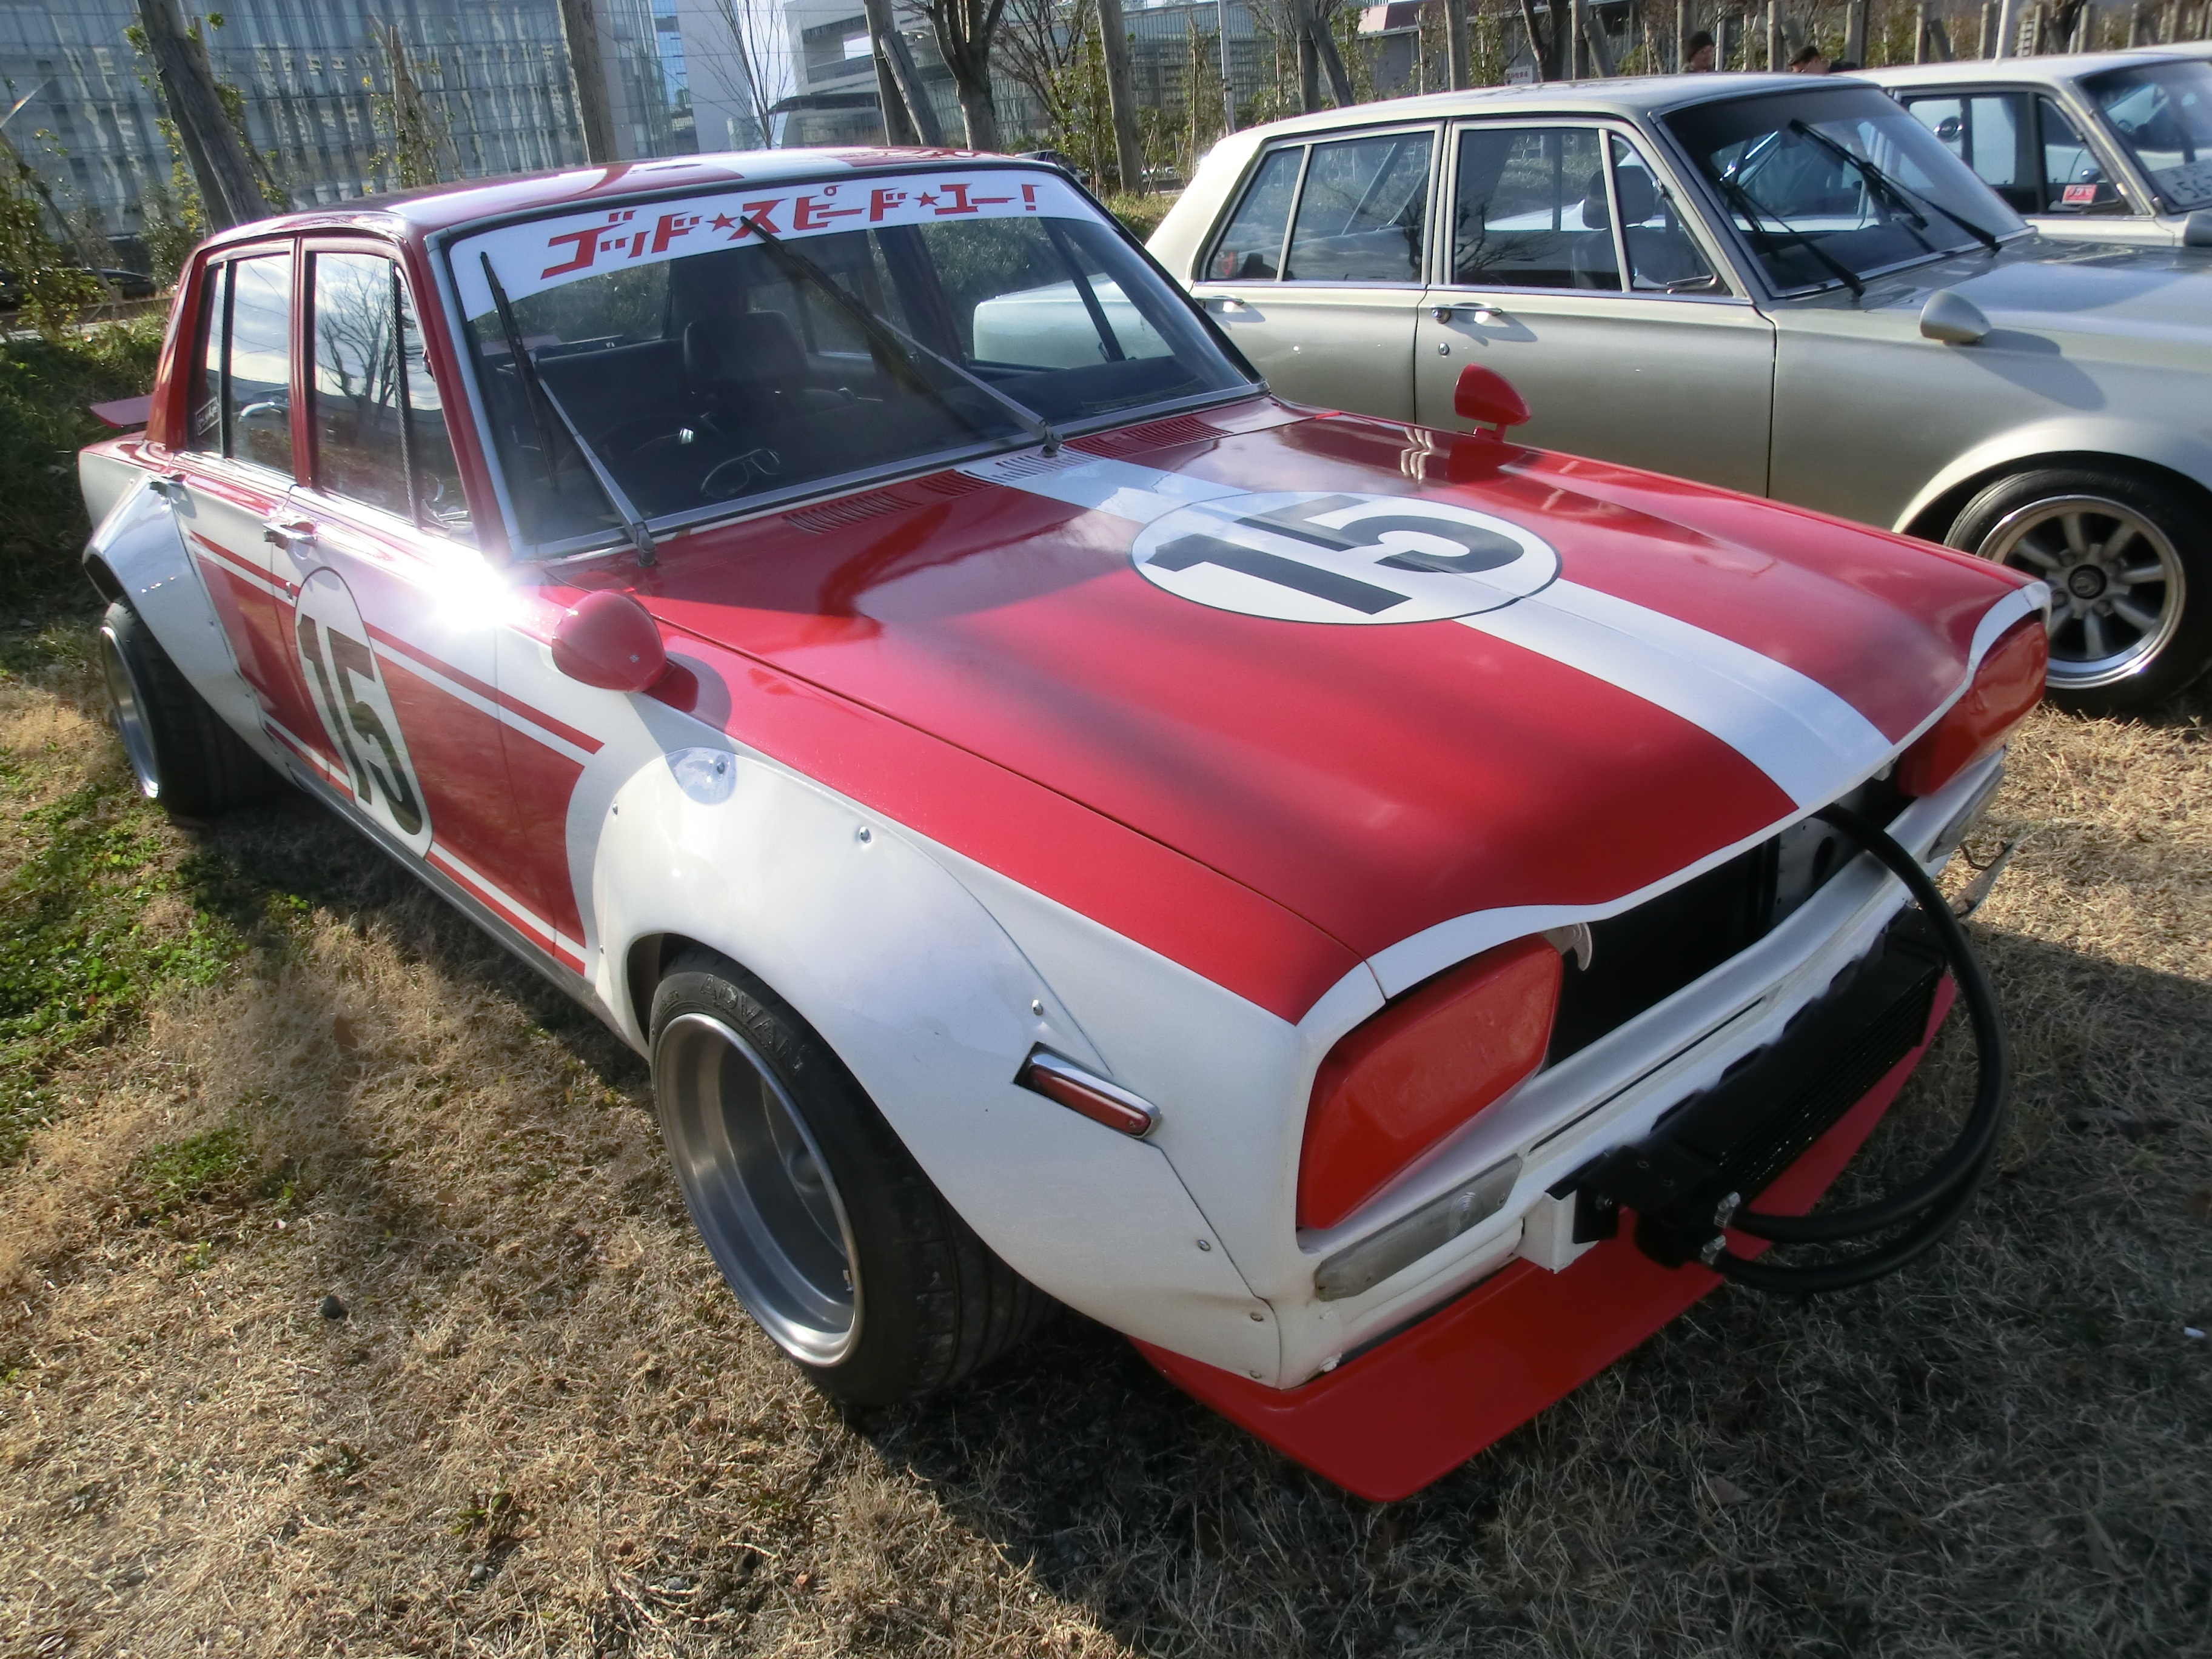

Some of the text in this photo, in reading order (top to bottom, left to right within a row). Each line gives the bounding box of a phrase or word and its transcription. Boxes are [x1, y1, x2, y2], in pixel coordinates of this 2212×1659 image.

[1144, 494, 1526, 615] 15
[297, 613, 423, 835] 15
[700, 973, 809, 1076] ADVAN
